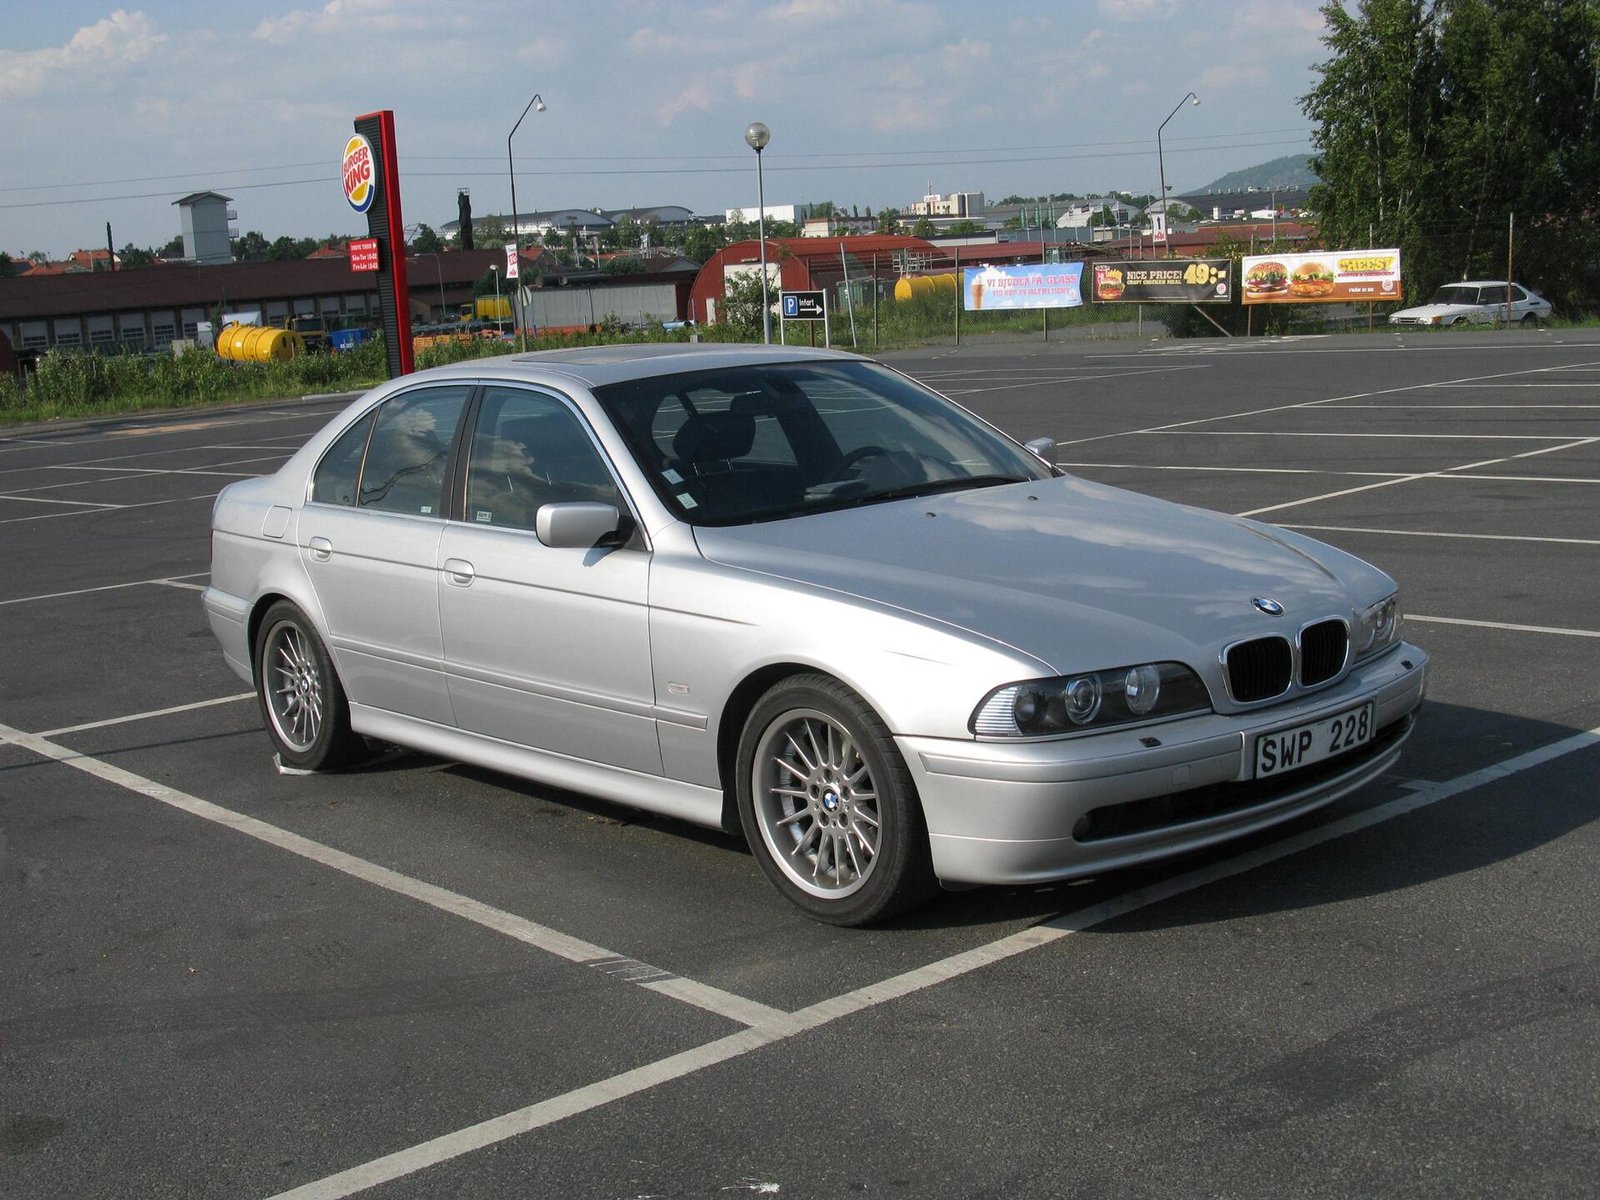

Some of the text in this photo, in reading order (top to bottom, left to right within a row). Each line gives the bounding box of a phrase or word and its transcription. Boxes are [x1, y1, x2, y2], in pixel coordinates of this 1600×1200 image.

[343, 146, 368, 177] BURGER
[344, 160, 371, 197] KING
[987, 279, 995, 288] VI
[998, 278, 1029, 289] BJUDER
[1047, 275, 1077, 284] GLASS
[1127, 263, 1226, 285] NICE PRICE! 49:-
[788, 299, 794, 313] P
[1261, 709, 1369, 773] SWP 228
